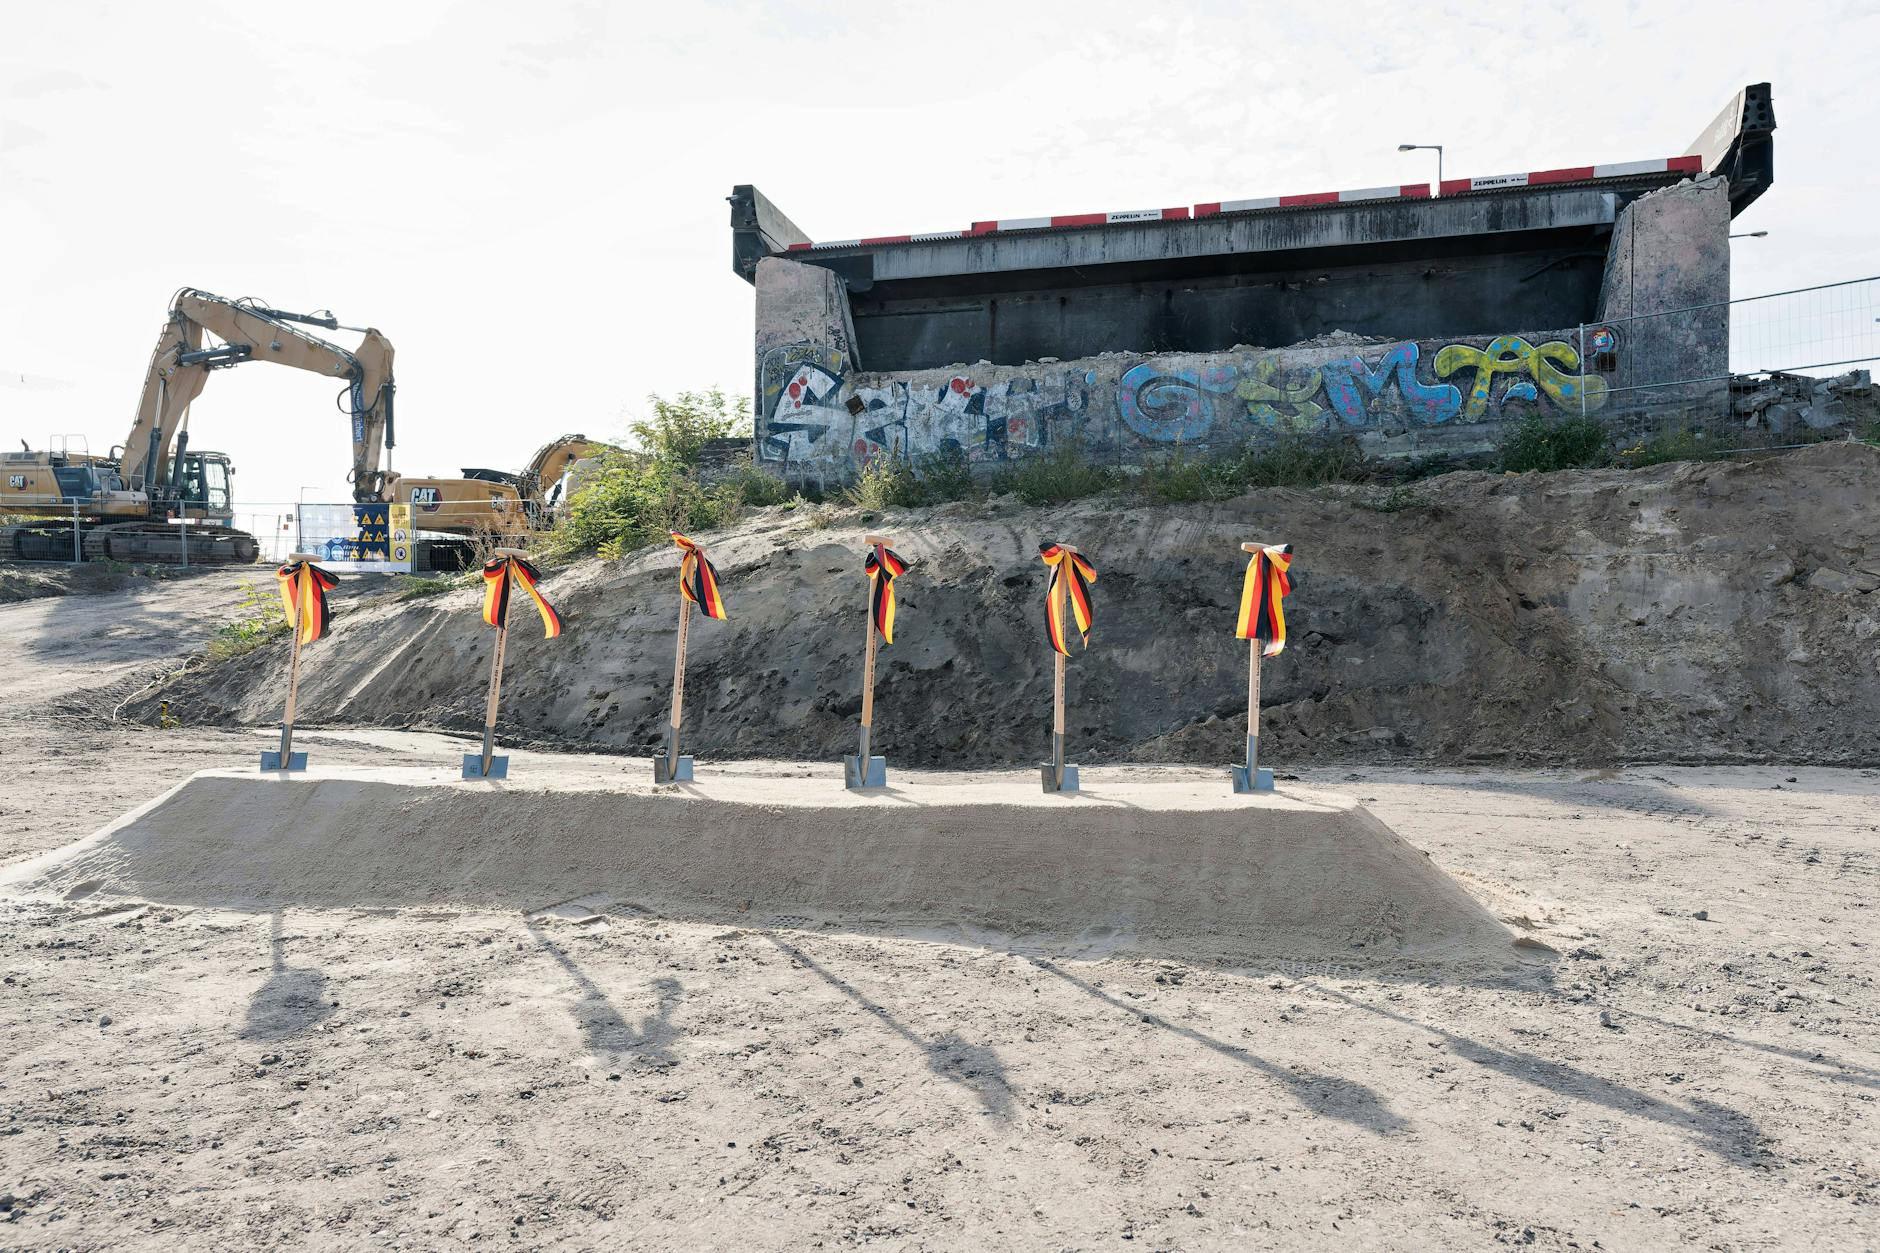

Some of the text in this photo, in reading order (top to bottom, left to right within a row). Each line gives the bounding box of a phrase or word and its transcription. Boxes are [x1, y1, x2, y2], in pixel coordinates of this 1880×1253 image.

[1474, 178, 1507, 186] ZEPPELIN
[9, 475, 24, 487] CAT
[411, 488, 436, 506] CAT
